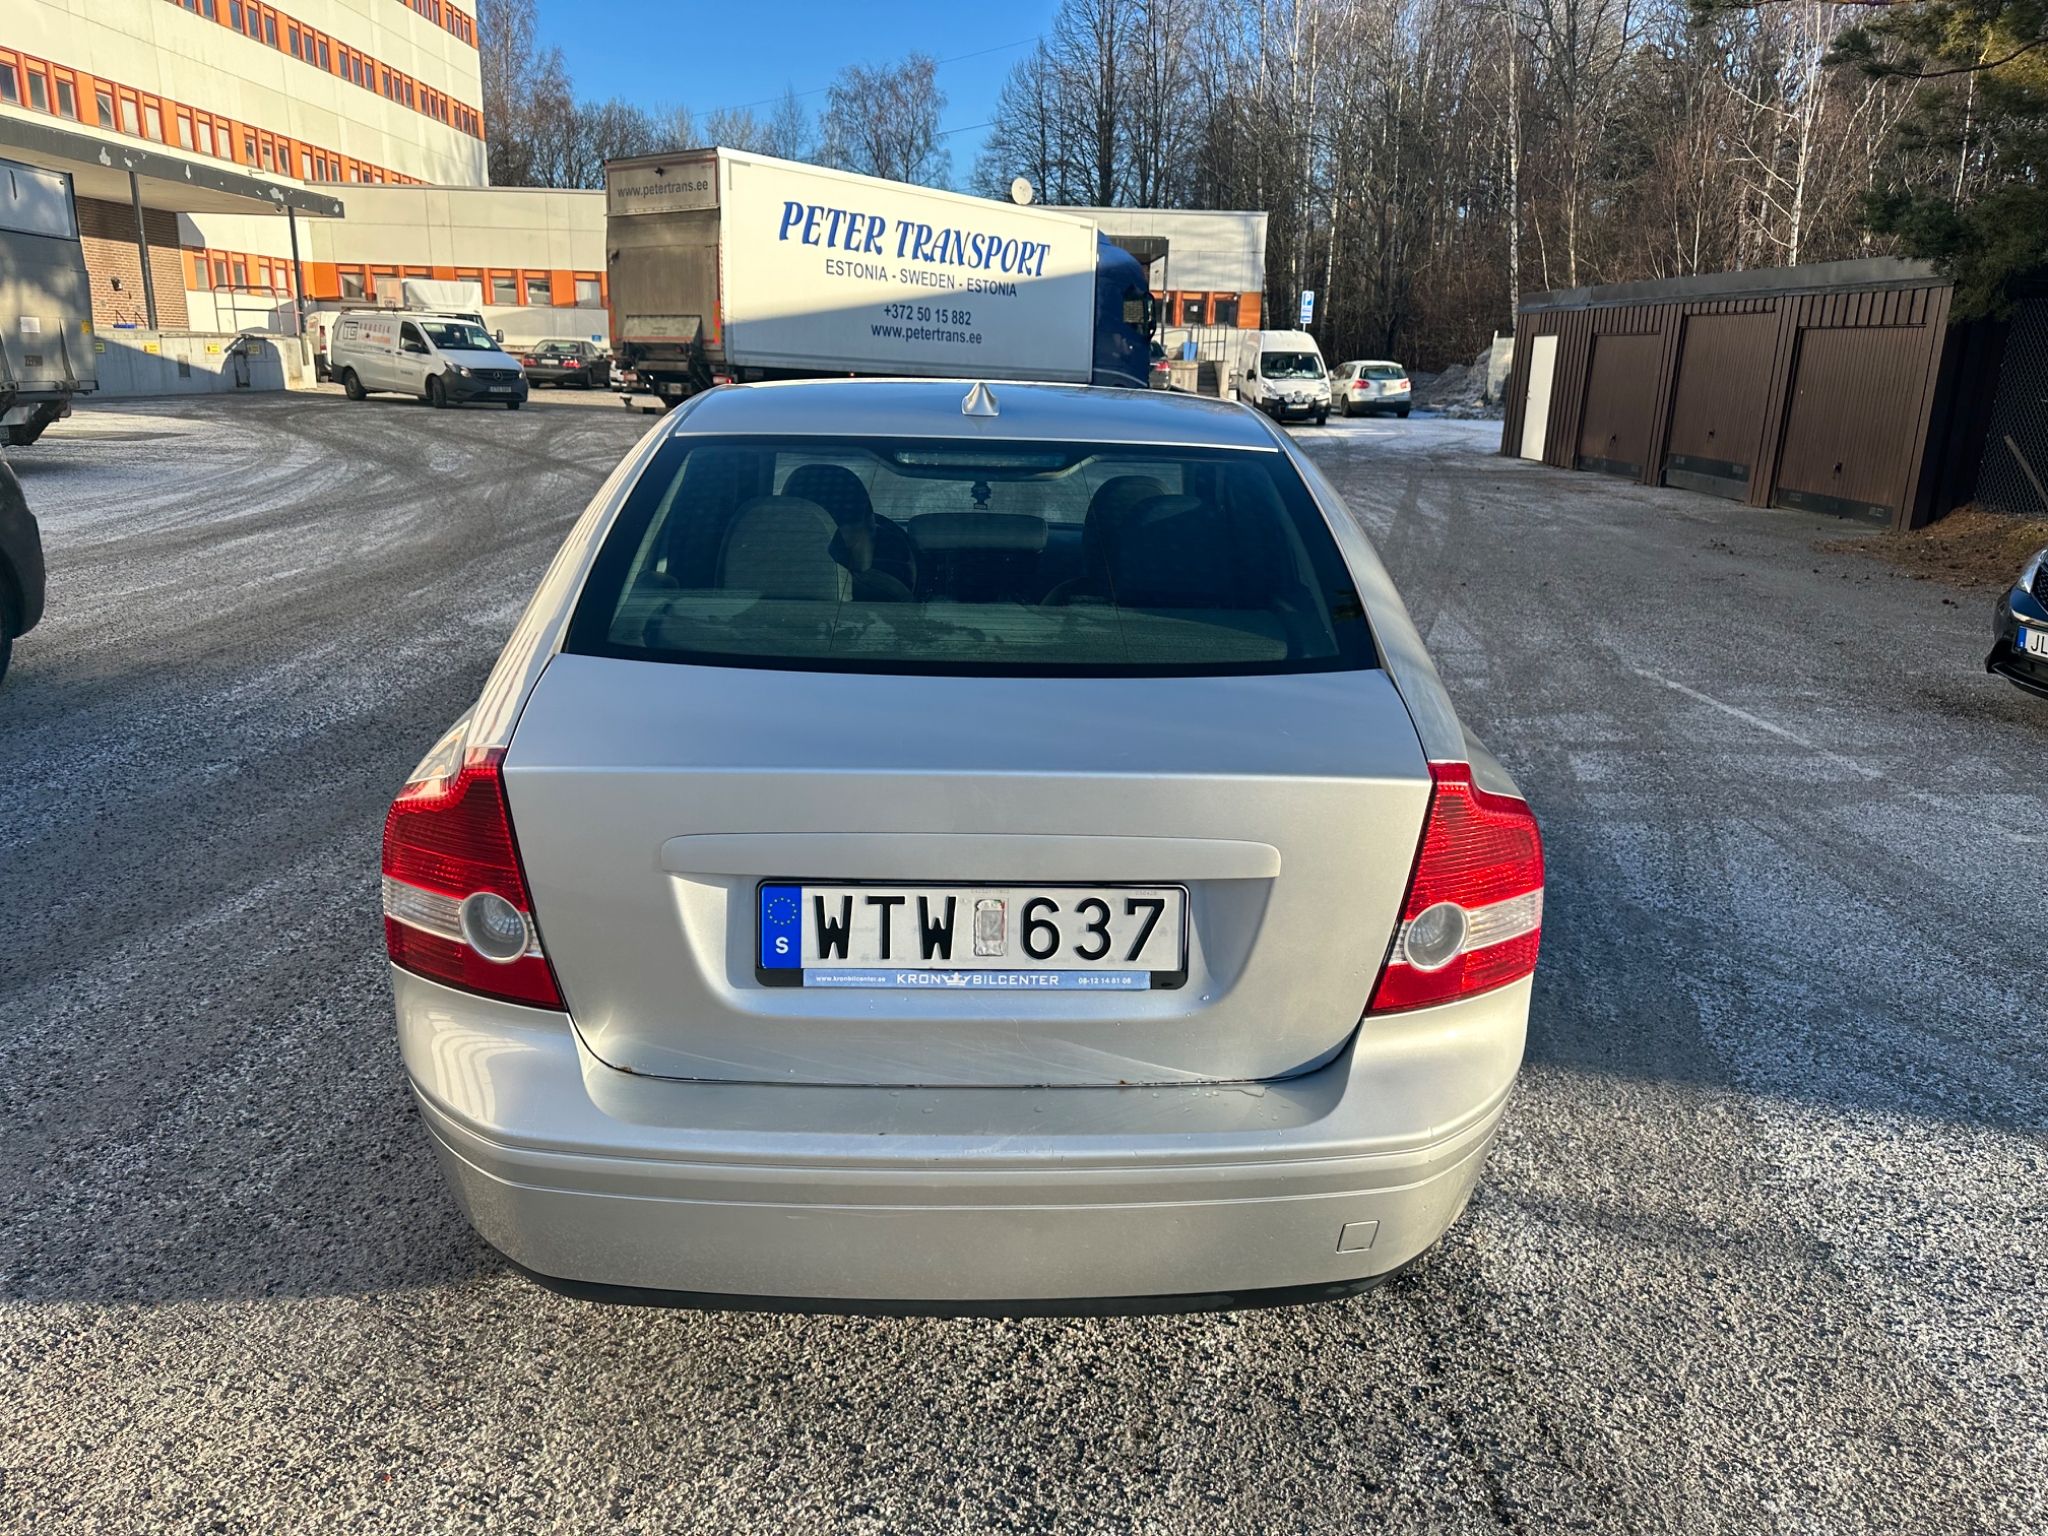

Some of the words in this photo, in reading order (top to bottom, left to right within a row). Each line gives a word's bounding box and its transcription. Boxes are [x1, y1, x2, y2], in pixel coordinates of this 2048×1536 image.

[617, 180, 708, 199] www.petertrans.ee
[779, 201, 886, 256] PETER
[895, 220, 1051, 277] TRANSPORT
[826, 258, 888, 282] ESTONIA
[900, 269, 955, 290] SWEDEN
[966, 278, 1017, 297] ESTONIA
[884, 304, 913, 321] +372
[917, 306, 931, 322] 50
[935, 308, 949, 324] 15
[951, 310, 972, 326] 882
[871, 324, 982, 344] www.petertrans.ee
[814, 895, 956, 960] WTW
[1020, 896, 1165, 961] 637
[775, 936, 789, 954] S
[896, 973, 942, 984] KRON
[973, 974, 1059, 986] BILCENTER
